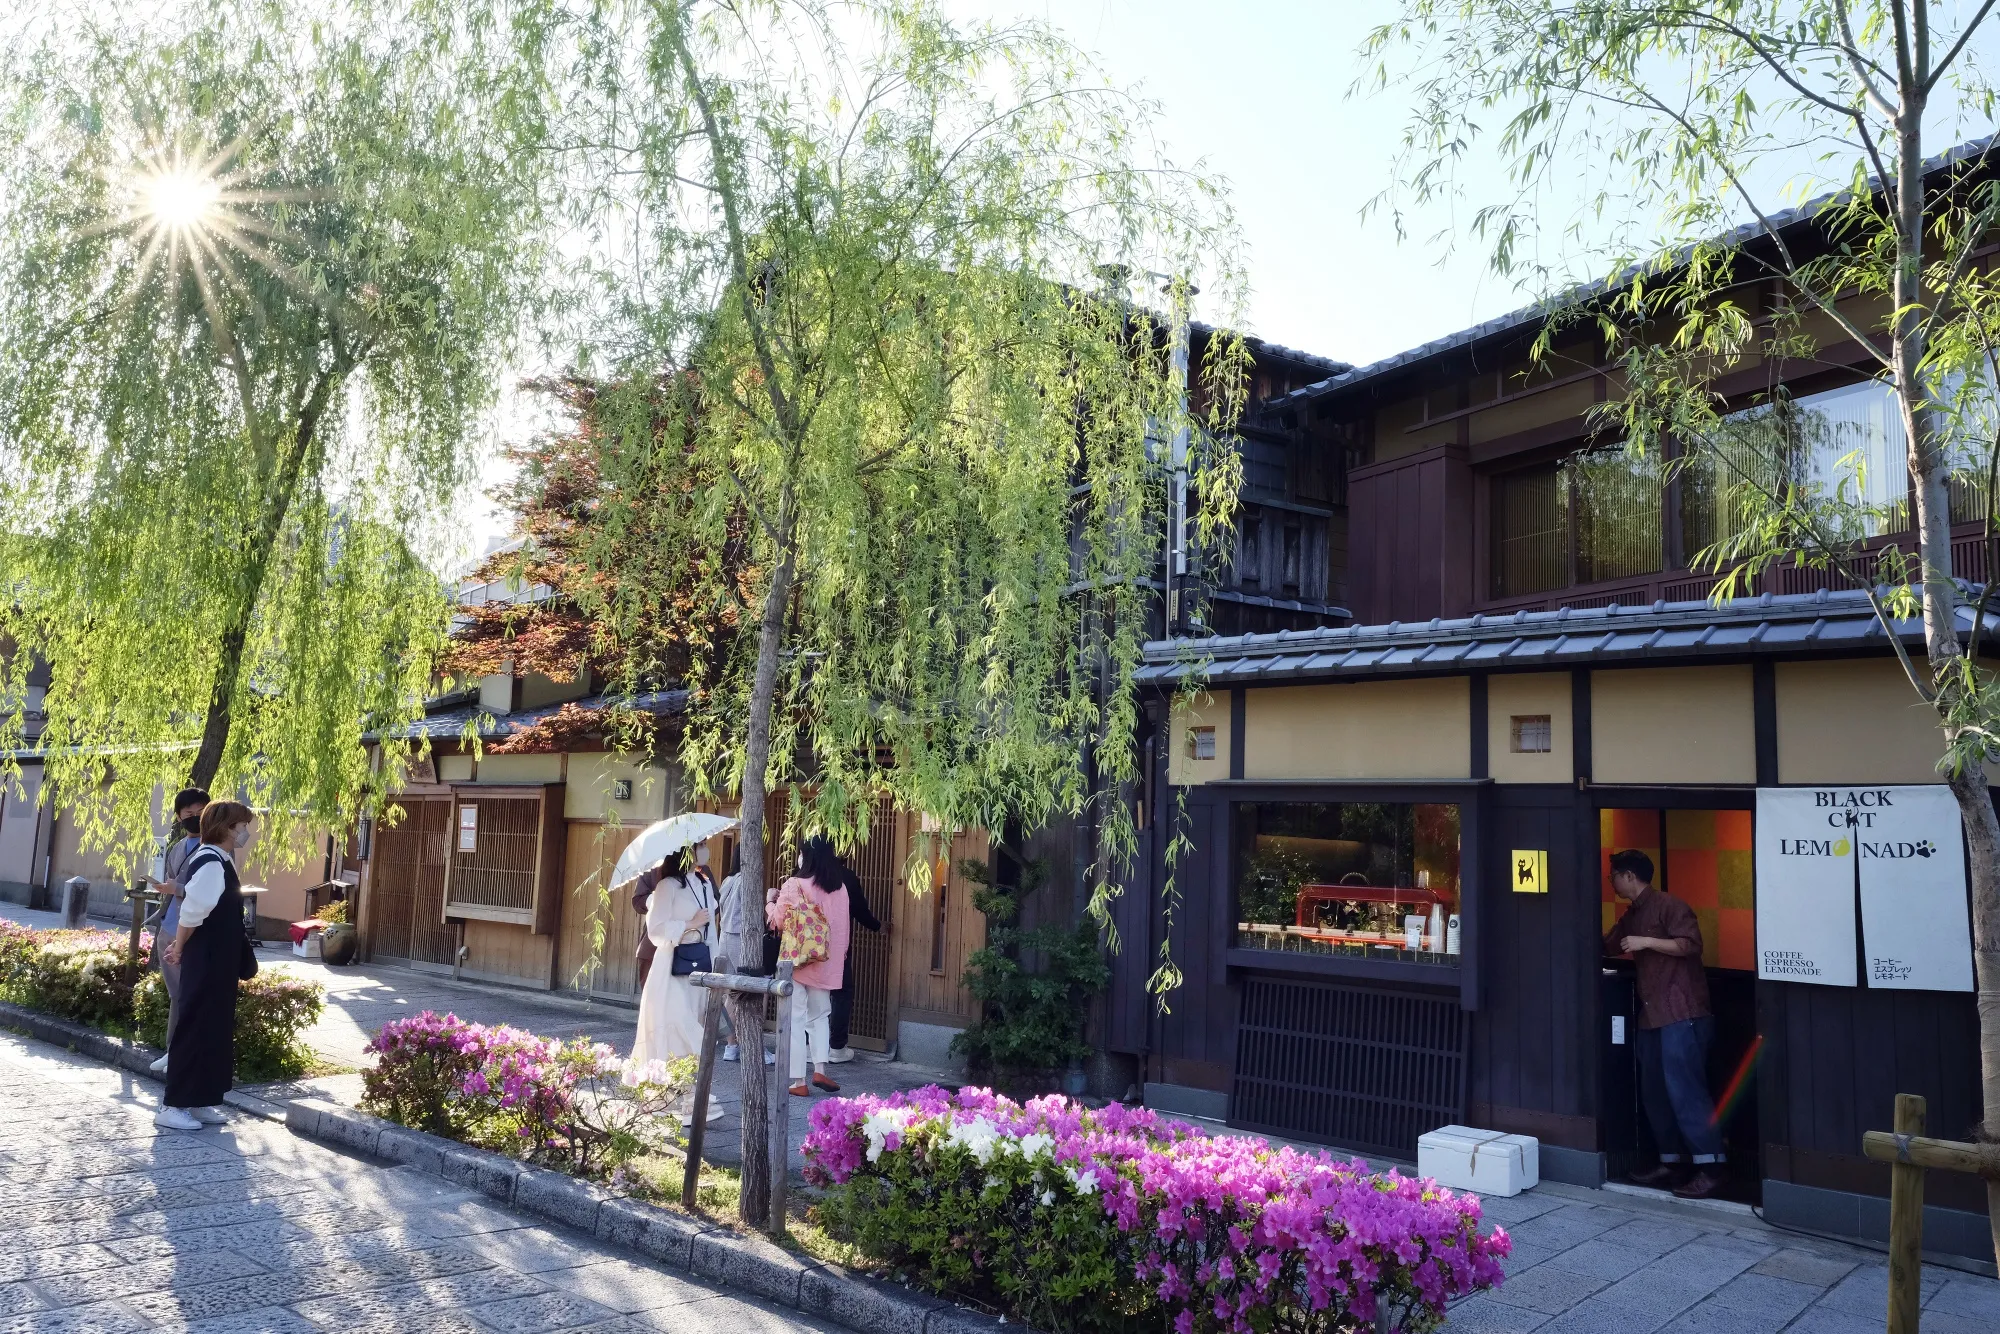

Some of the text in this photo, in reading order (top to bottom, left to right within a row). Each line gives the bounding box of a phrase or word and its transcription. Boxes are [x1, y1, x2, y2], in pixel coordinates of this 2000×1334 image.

[1814, 790, 1893, 807] BLACK
[1828, 808, 1877, 828] CT
[1764, 950, 1804, 959] COFFEE
[1765, 958, 1814, 967] ESPRESSO
[1874, 958, 1902, 966] コーヒー
[1765, 966, 1822, 976] LEMONADE
[1874, 965, 1912, 973] エスプレッソ
